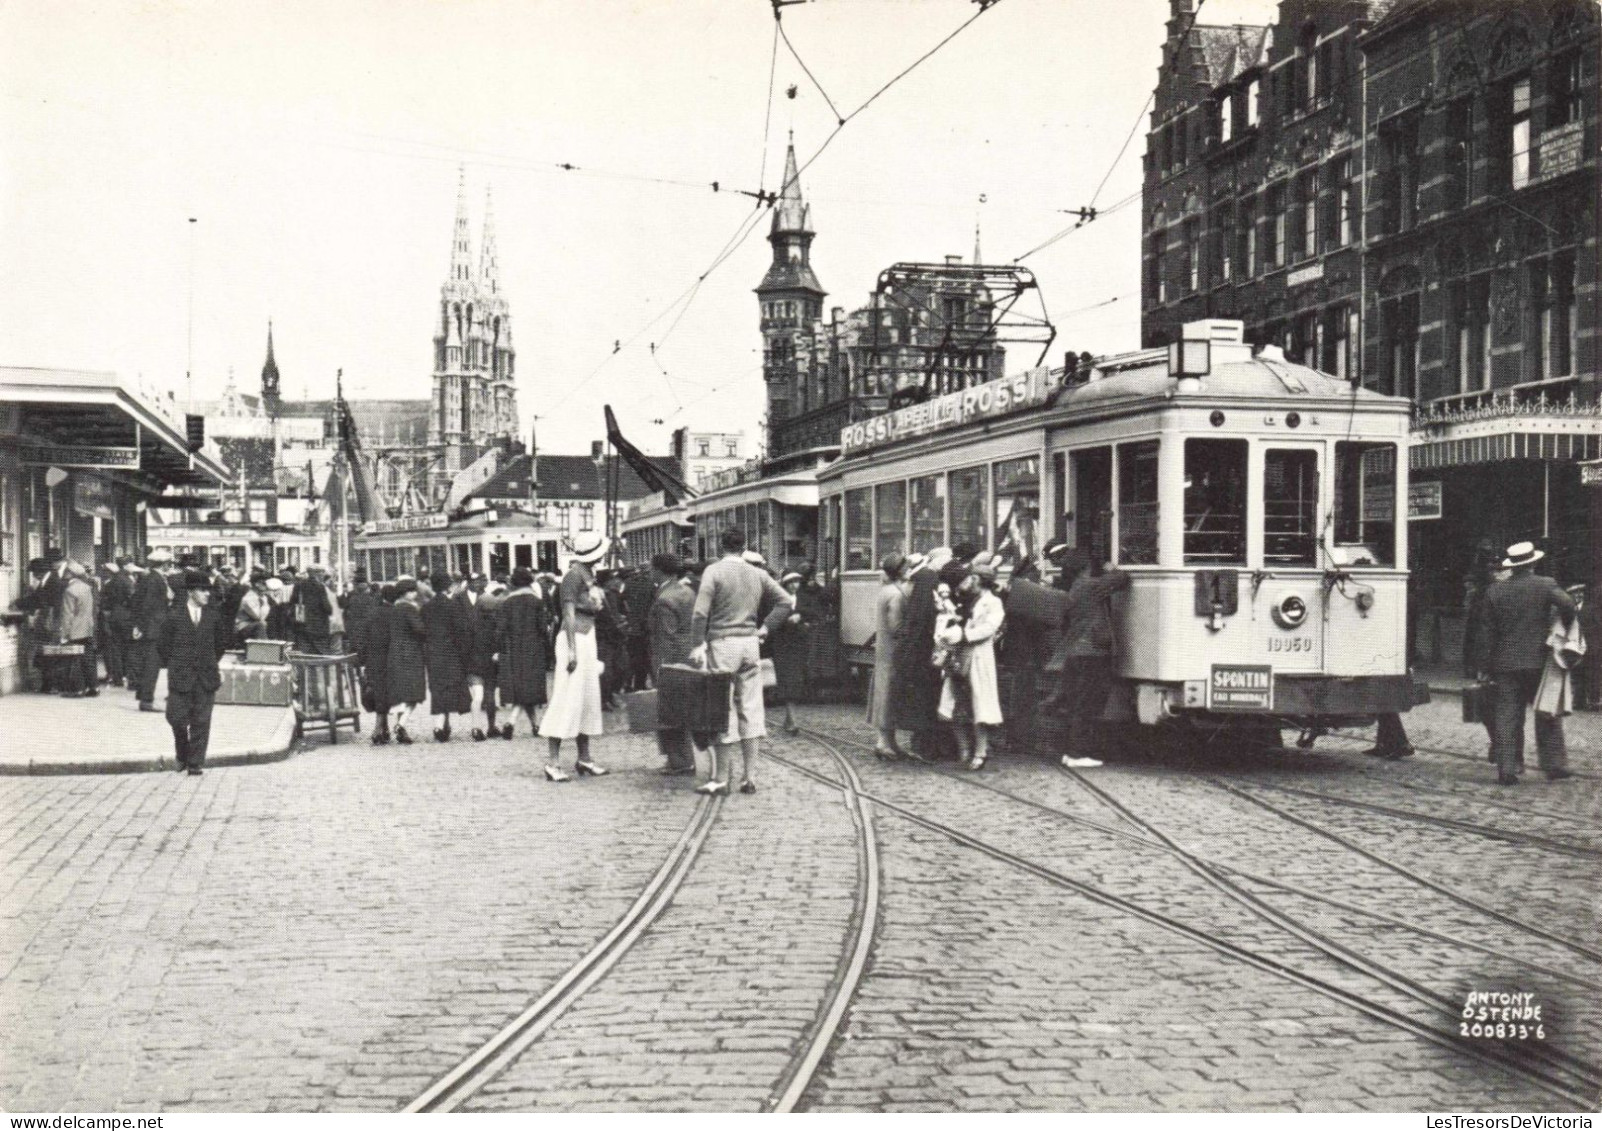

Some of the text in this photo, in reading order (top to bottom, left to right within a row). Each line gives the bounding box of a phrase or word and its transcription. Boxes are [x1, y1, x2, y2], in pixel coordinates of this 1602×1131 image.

[843, 417, 892, 449] ROSSI
[963, 374, 1036, 415] ROSSI
[1210, 573, 1224, 604] 1
[1213, 670, 1268, 688] SPONTIN
